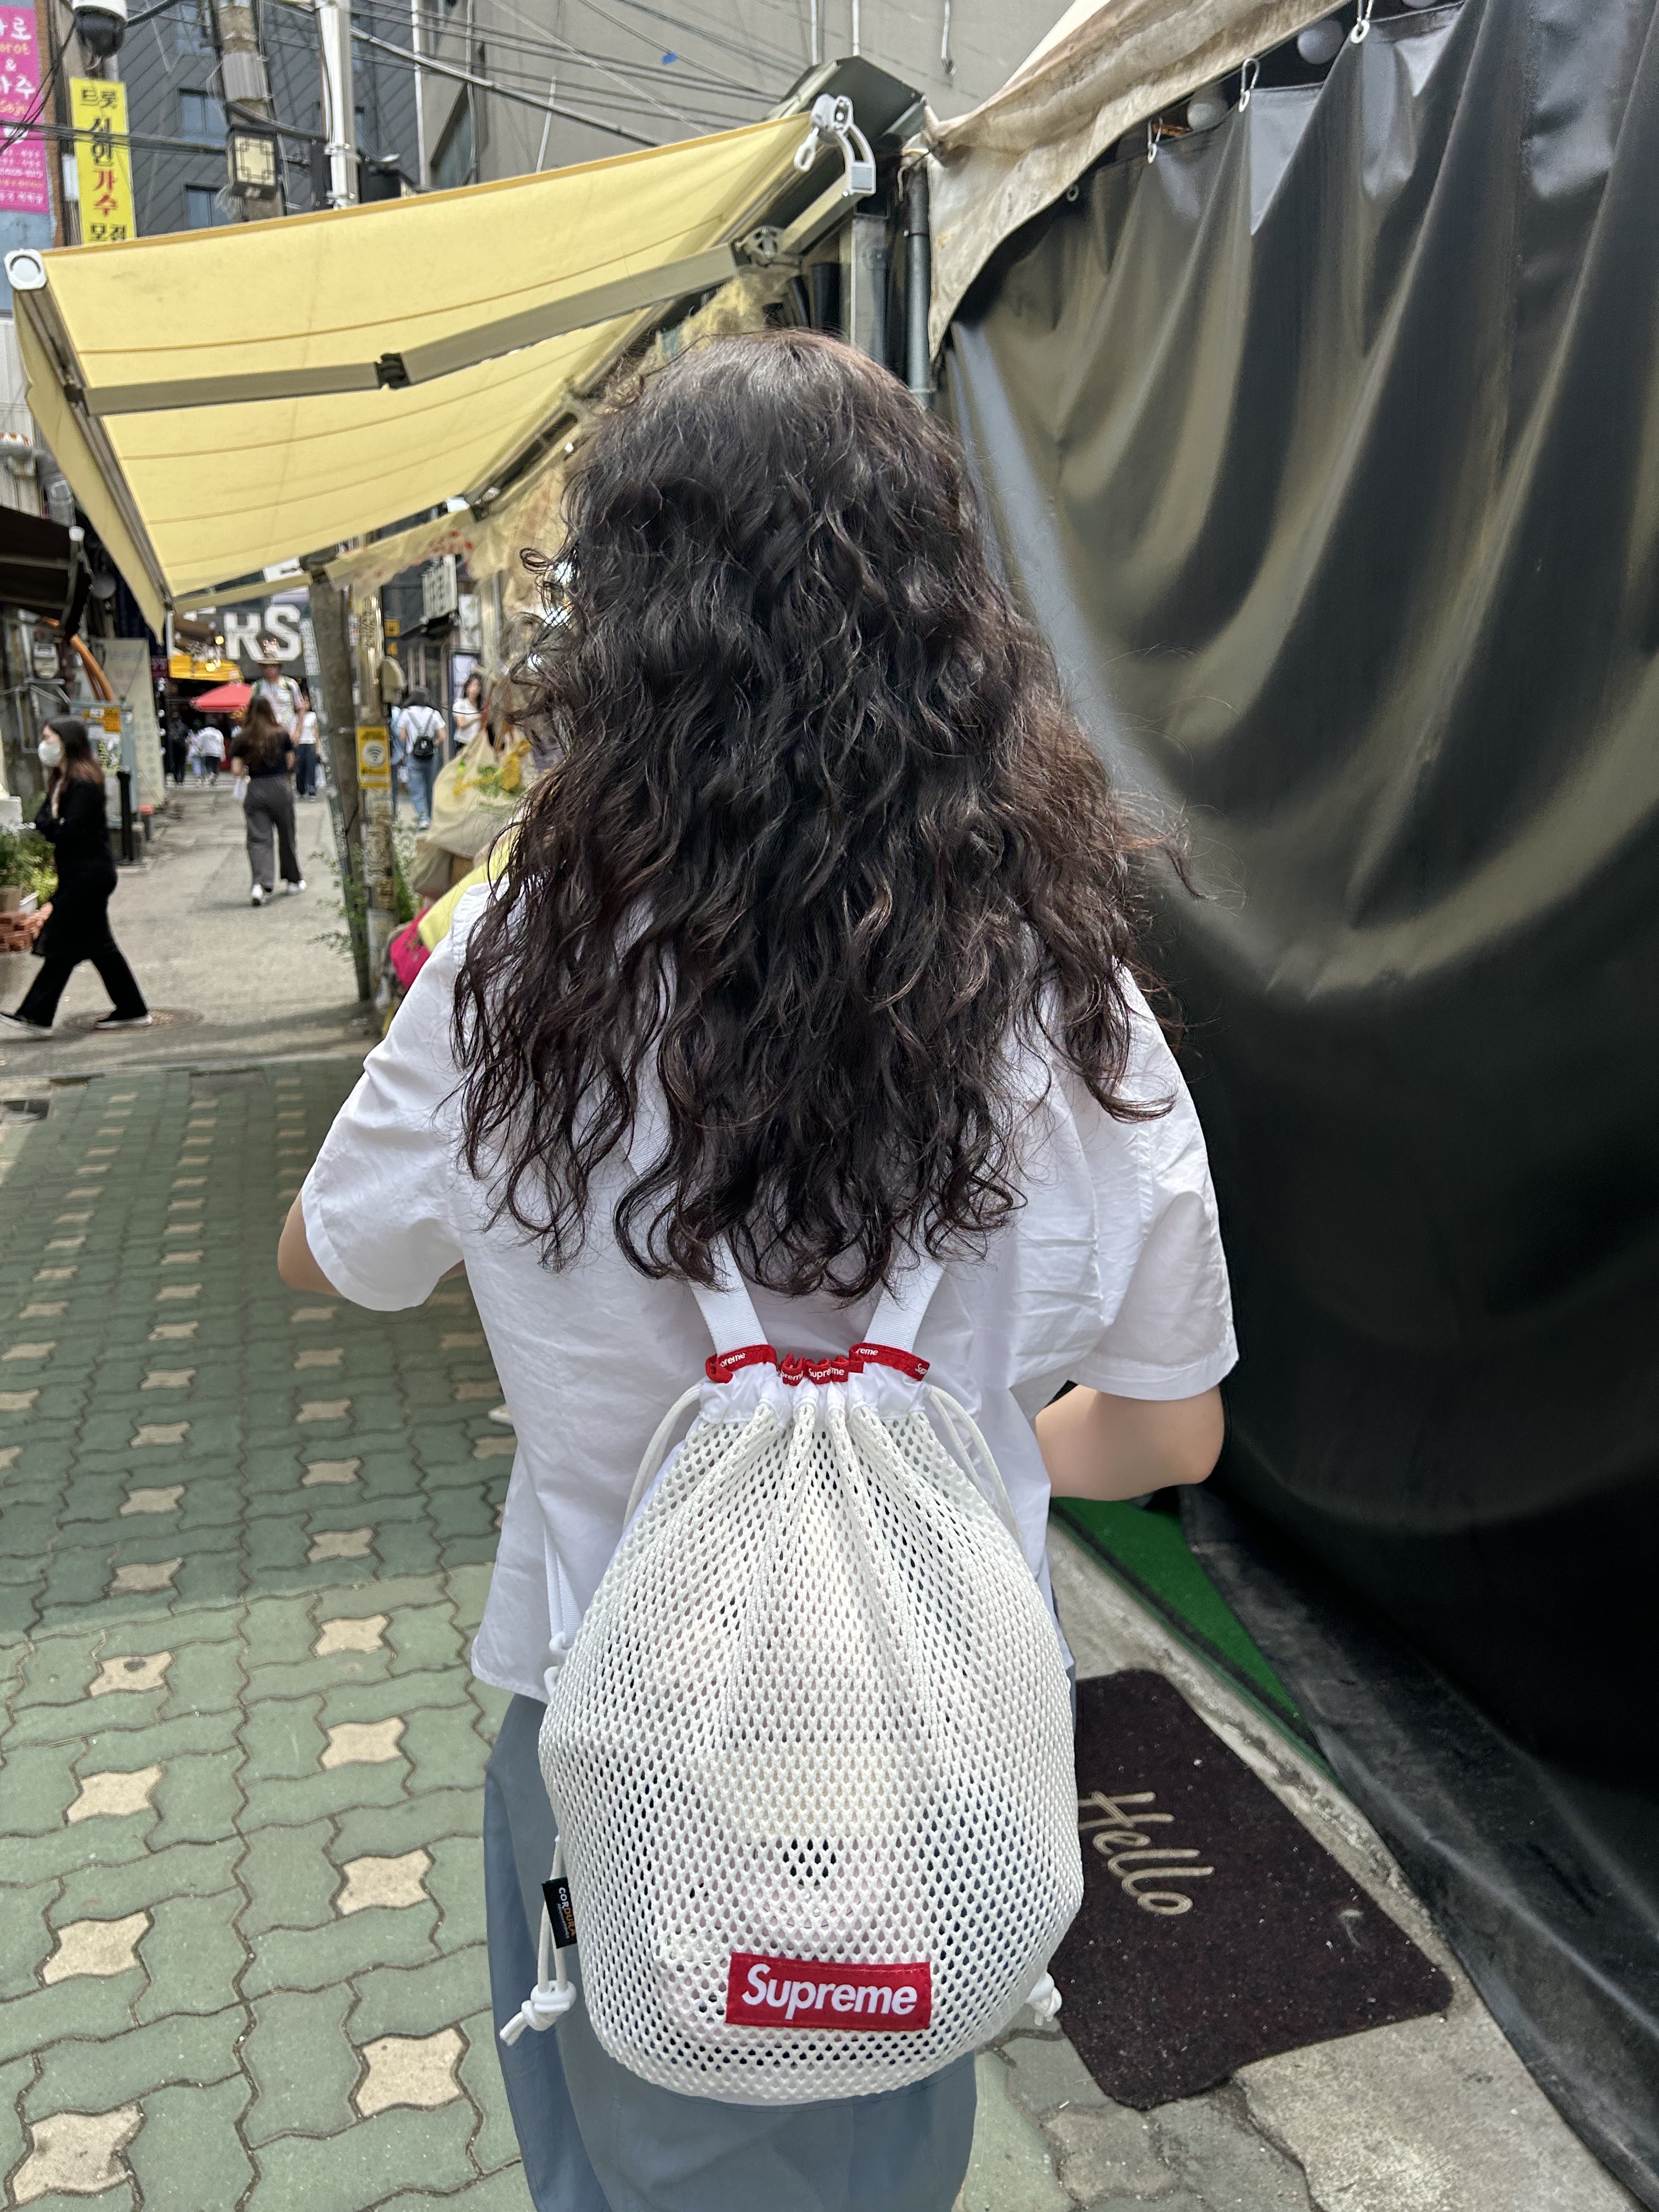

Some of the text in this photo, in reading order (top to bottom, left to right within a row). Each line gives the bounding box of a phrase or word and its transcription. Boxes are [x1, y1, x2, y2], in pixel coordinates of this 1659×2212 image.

[0, 16, 32, 40] 로
[855, 1347, 878, 1356] reme
[1078, 1791, 1215, 1915] Hello
[558, 1887, 577, 1937] CORDURA
[742, 1963, 918, 2021] Supreme
